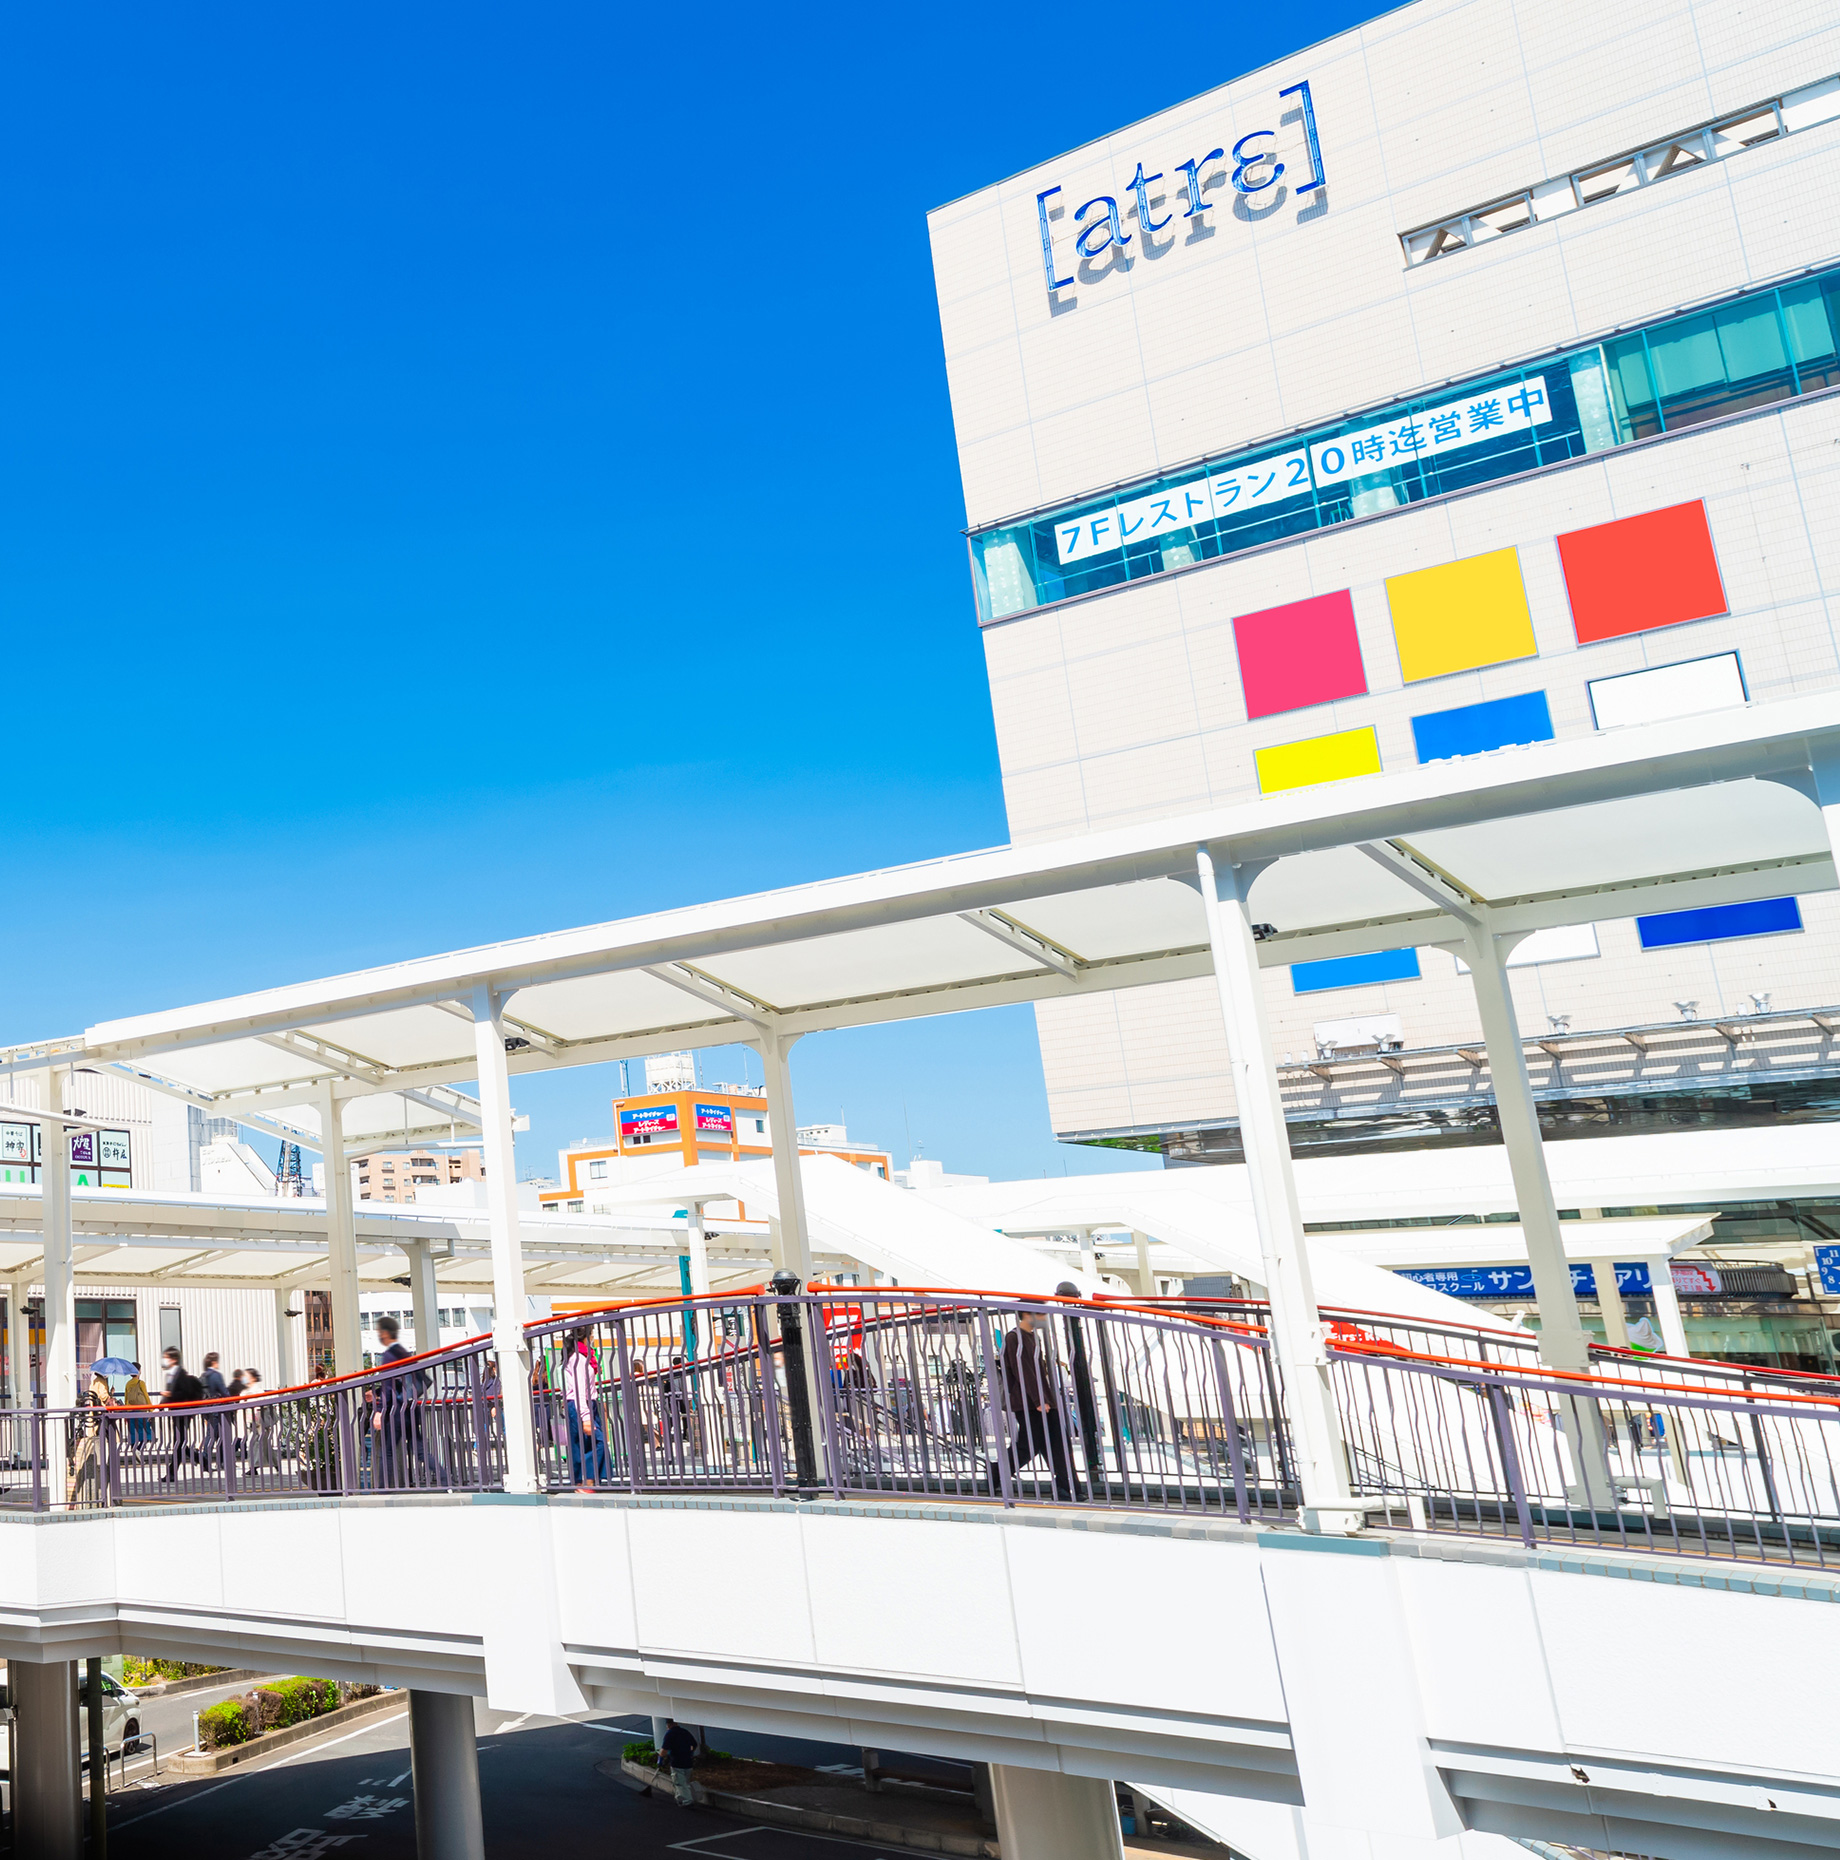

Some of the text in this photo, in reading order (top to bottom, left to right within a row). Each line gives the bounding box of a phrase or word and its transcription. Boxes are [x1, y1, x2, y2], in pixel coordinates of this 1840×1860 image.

[1829, 1249, 1839, 1258] 11
[1821, 1257, 1833, 1265] 10
[1821, 1266, 1828, 1276] 9
[1827, 1275, 1836, 1284] 8
